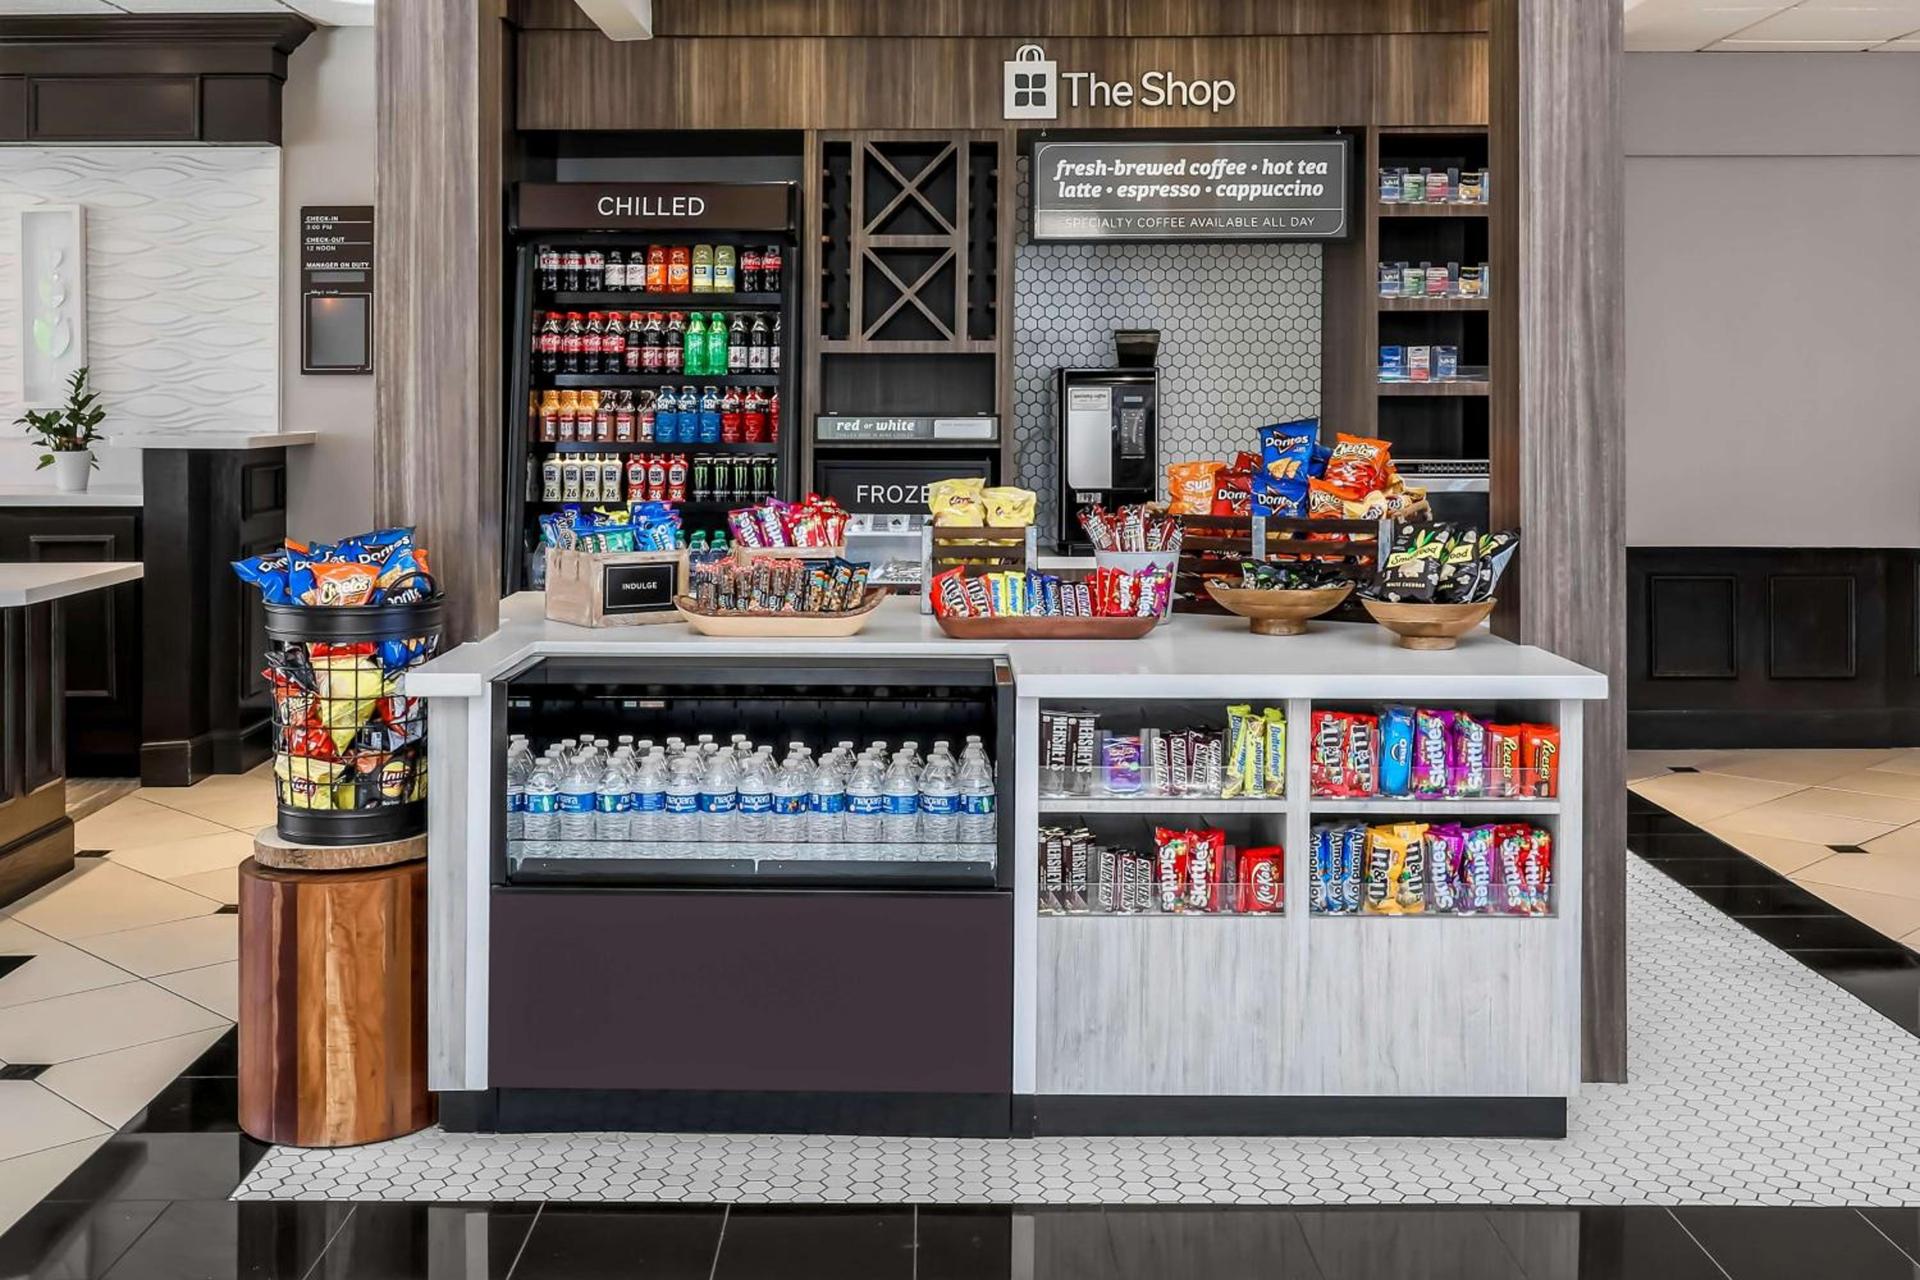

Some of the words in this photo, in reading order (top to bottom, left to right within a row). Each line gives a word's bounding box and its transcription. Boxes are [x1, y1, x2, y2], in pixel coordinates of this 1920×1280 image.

[1062, 72, 1134, 107] The
[1141, 71, 1236, 112] Shop
[1053, 159, 1186, 180] fresh-brewed
[1189, 158, 1247, 180] coffee
[1261, 158, 1294, 176] hot
[1297, 160, 1328, 175] tea
[1058, 181, 1103, 199] latte
[1116, 183, 1201, 201] espresso
[1215, 180, 1324, 201] cappuccino
[597, 196, 705, 216] CHILLED
[1065, 217, 1133, 229] SPECIALTY
[1136, 217, 1186, 228] COFFEE
[1189, 217, 1258, 228] AVAILABLE
[1262, 217, 1286, 227] ALL
[1290, 216, 1316, 227] DAY
[836, 419, 860, 431] red
[876, 419, 915, 431] white
[1265, 434, 1309, 447] Doritos
[1332, 442, 1378, 459] Cheetos
[856, 484, 930, 504] FROZE
[1217, 488, 1251, 500] Dorit
[1257, 493, 1300, 511] Doritos
[1310, 490, 1342, 512] Cheeto
[358, 534, 411, 565] Doritos
[321, 577, 371, 603] Cheetos
[621, 581, 658, 591] INDULGE
[1270, 725, 1281, 777] Butterfinger
[1426, 718, 1446, 788] Skittles
[1310, 832, 1321, 883] Almond
[1330, 832, 1344, 881] Almond
[1351, 832, 1365, 880] Almond
[1160, 847, 1178, 911] Skittles
[1190, 842, 1209, 908] Skittles
[1432, 840, 1453, 908] Skittles
[1469, 839, 1489, 907] Skittles
[1504, 839, 1521, 907] Skittles
[1310, 882, 1321, 908] Joy
[1330, 881, 1344, 903] Joy
[1349, 880, 1361, 901] Joy
